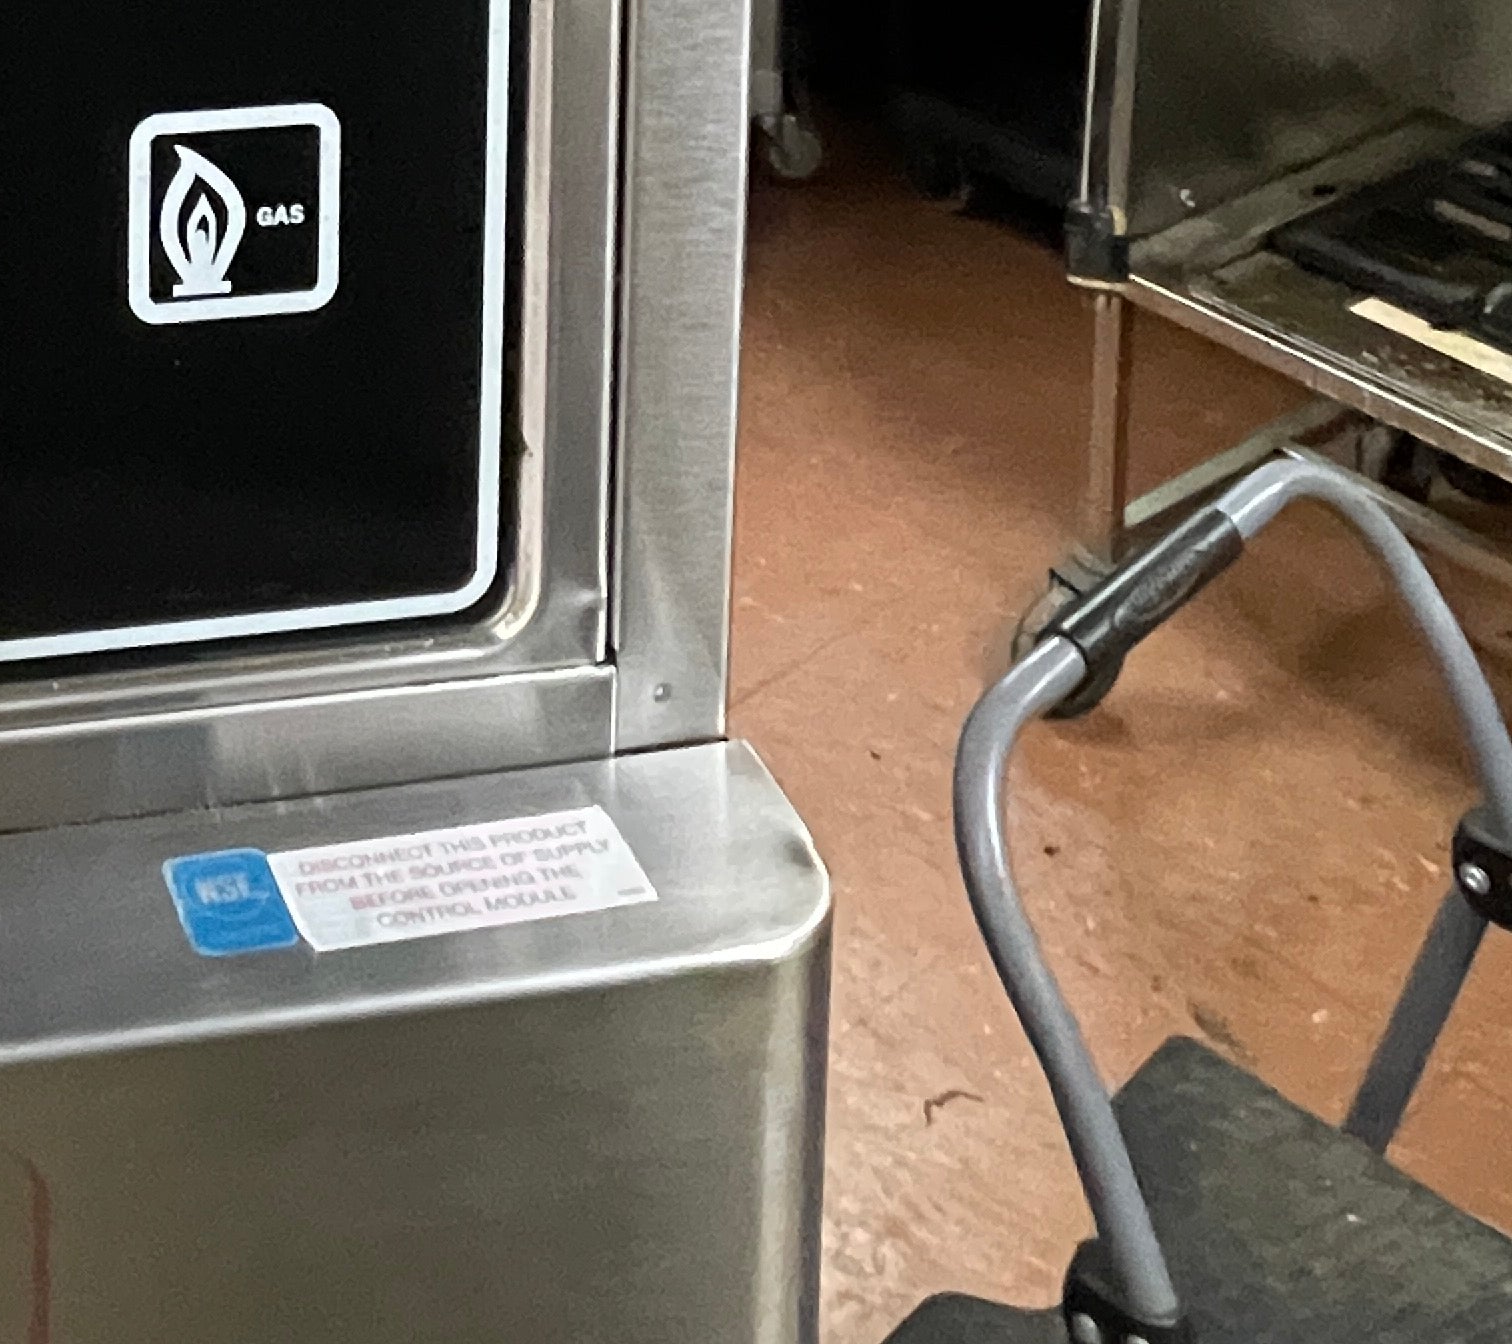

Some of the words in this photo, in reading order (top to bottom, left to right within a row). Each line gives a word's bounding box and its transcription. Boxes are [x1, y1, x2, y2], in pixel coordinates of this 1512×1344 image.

[256, 202, 306, 228] GAS
[295, 874, 360, 897] FROM
[361, 868, 406, 888] THE
[408, 856, 498, 880] SOURCE
[500, 851, 526, 866] OF
[532, 838, 609, 862] SUPPLY
[298, 842, 432, 877] DISCONNECT
[439, 829, 486, 854] THIS
[488, 820, 587, 847] PRODUCT
[349, 885, 438, 910] BEFORE
[438, 870, 536, 897] OPENING
[538, 864, 584, 882] THE
[377, 901, 484, 927] CONTROL
[484, 886, 578, 912] MODULE
